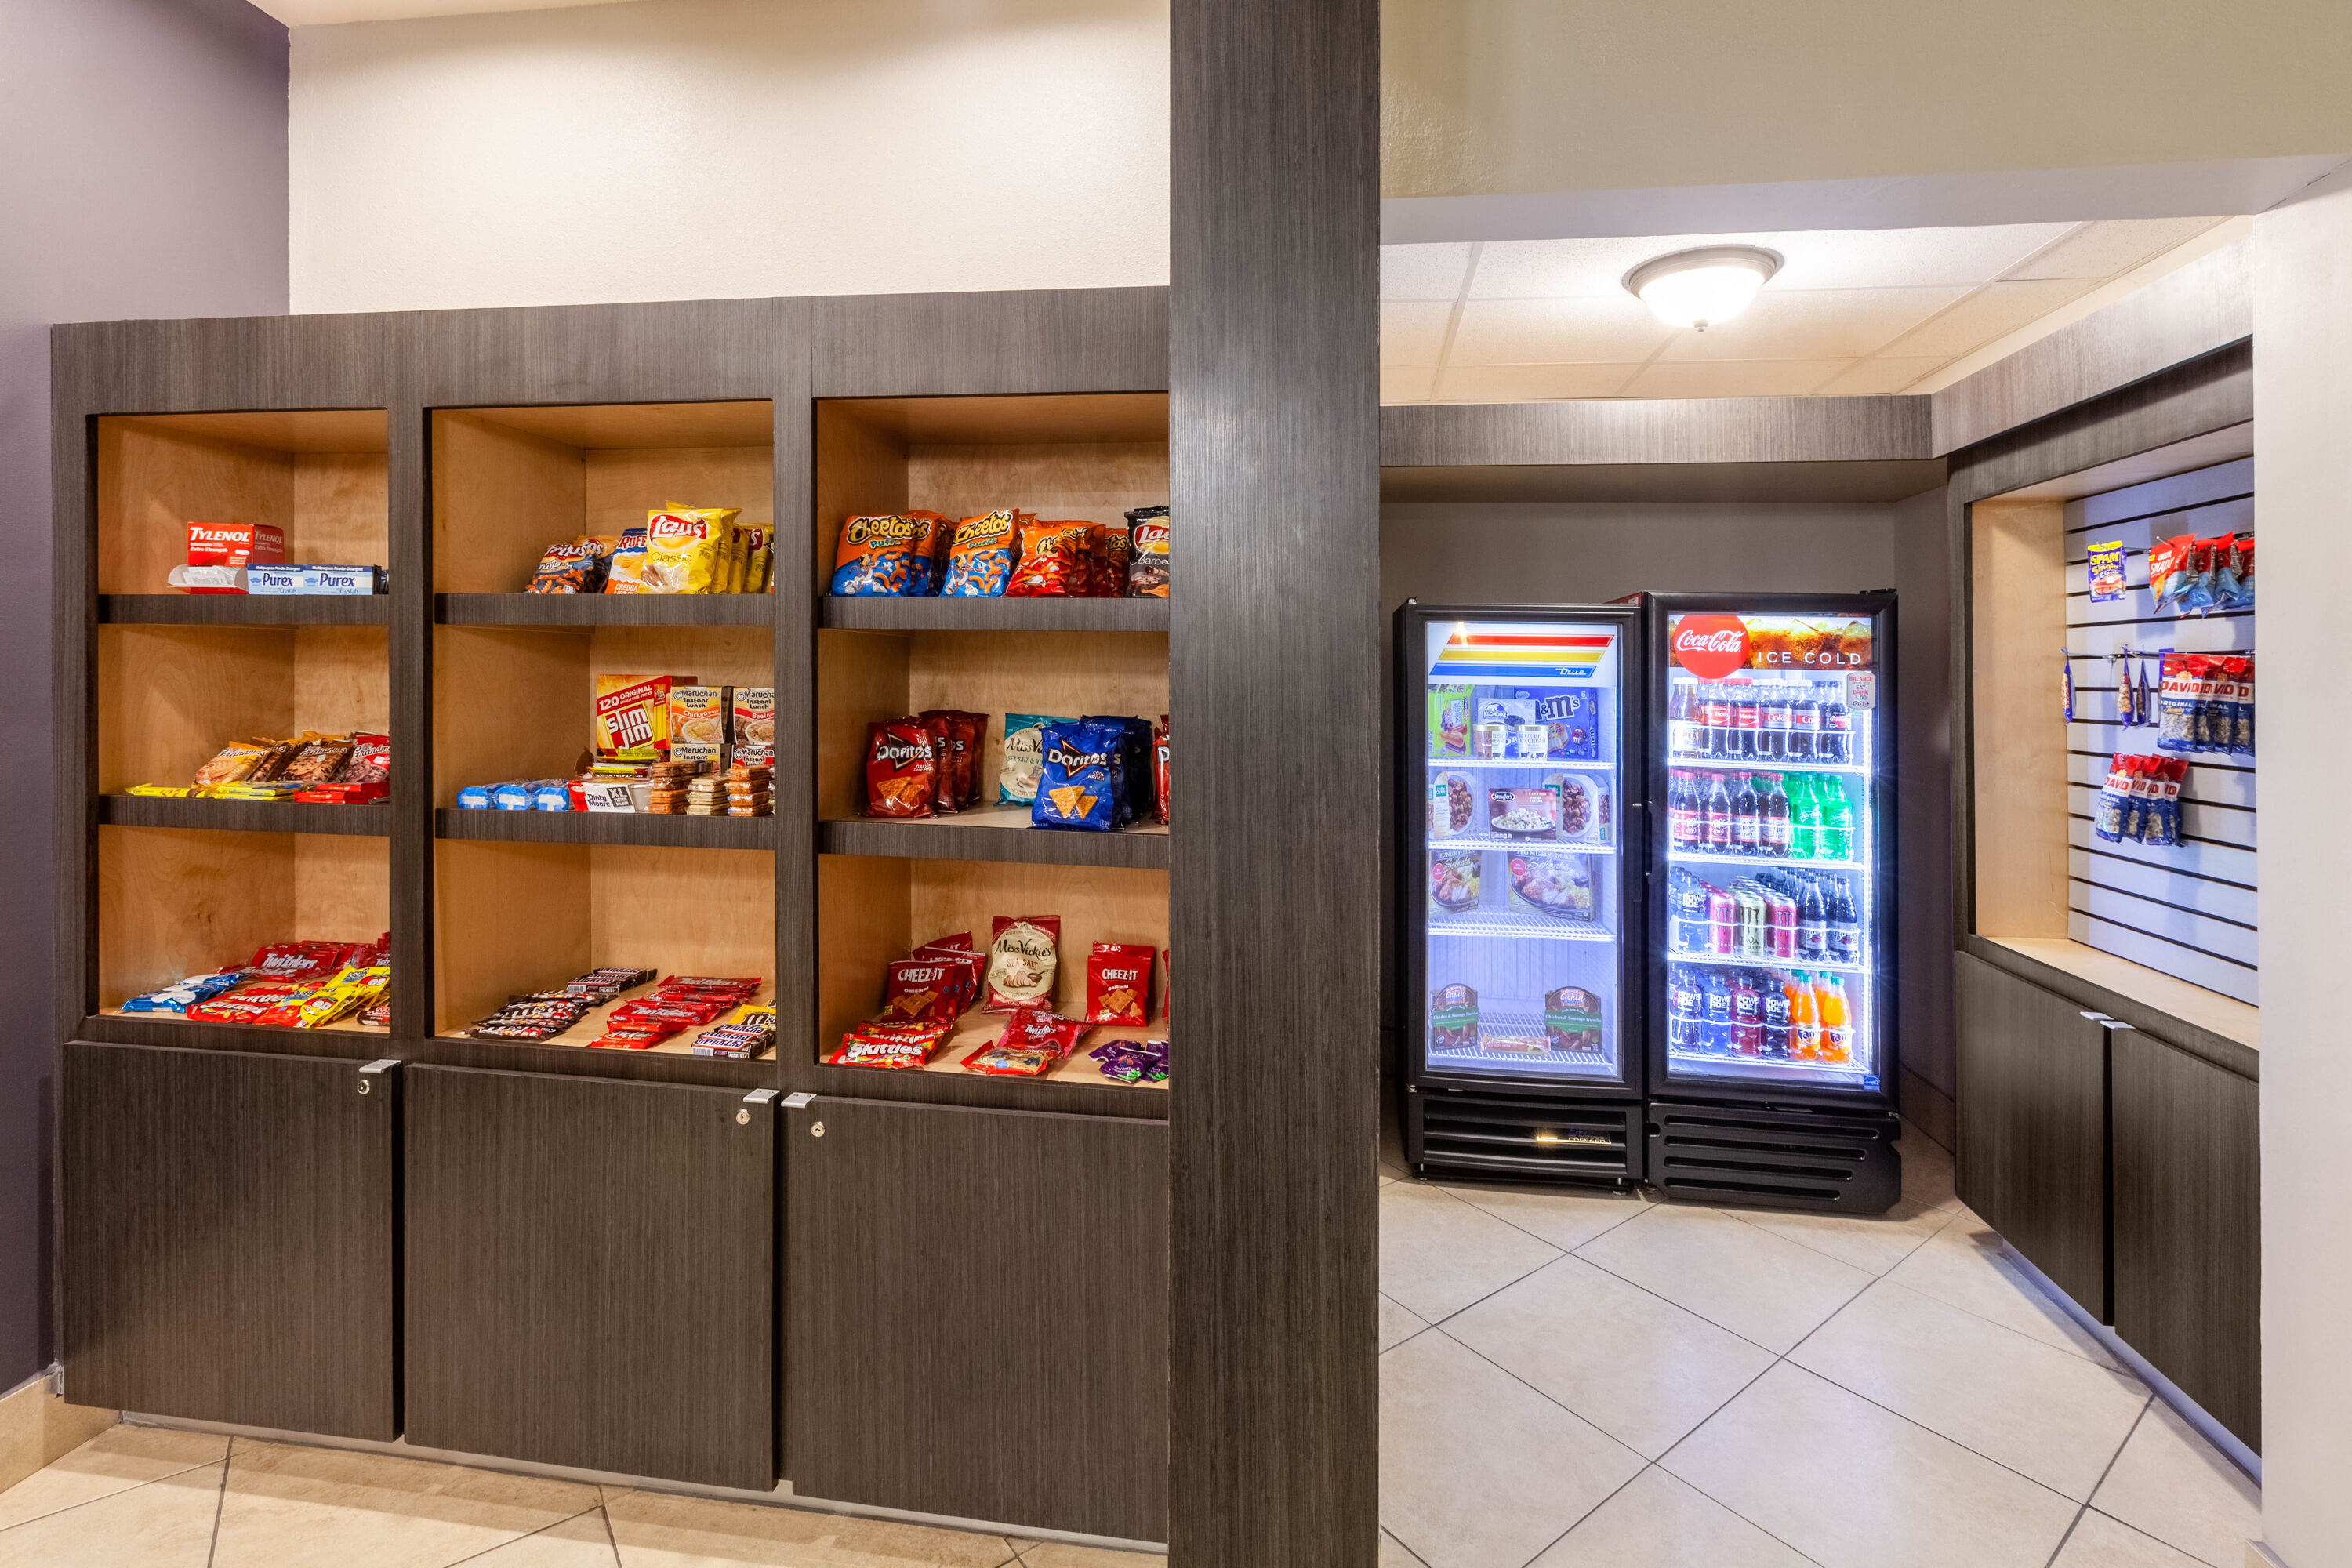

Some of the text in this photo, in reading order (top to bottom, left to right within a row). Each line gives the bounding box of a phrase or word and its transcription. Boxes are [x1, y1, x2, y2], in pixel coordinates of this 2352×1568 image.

[652, 514, 706, 539] Lay's
[848, 515, 913, 543] Cheetos
[953, 510, 1012, 544] Cheetos
[190, 527, 250, 542] TYLENOL
[254, 531, 283, 543] TYLENOL
[618, 535, 648, 549] RUFF
[967, 539, 998, 549] Puffs
[651, 551, 692, 563] Classic
[2090, 551, 2121, 566] SPAM
[263, 572, 294, 586] Purex
[319, 572, 356, 587] Purex
[615, 583, 639, 592] CHEDDA
[1676, 630, 1746, 652] Coca-Cola
[1758, 652, 1862, 666] ICE COLD
[619, 684, 652, 700] ORIGINAL
[2161, 681, 2201, 693] DAVID
[599, 695, 620, 712] 120
[1767, 713, 1788, 722] Coke
[352, 746, 390, 758] Grandm
[1006, 737, 1031, 753] Miss
[742, 748, 774, 757] Maruchan
[877, 745, 933, 760] Doritos
[1047, 748, 1109, 768] Doritos
[2104, 776, 2130, 791] DAVD
[587, 793, 607, 802] Dinty
[608, 787, 628, 799] XL
[1493, 793, 1513, 801] Stouffer's
[994, 938, 1051, 962] Miss Vickie's
[1007, 958, 1039, 969] SEA SALT
[1559, 992, 1586, 1003] Cajun
[848, 1042, 924, 1058] Skittles
